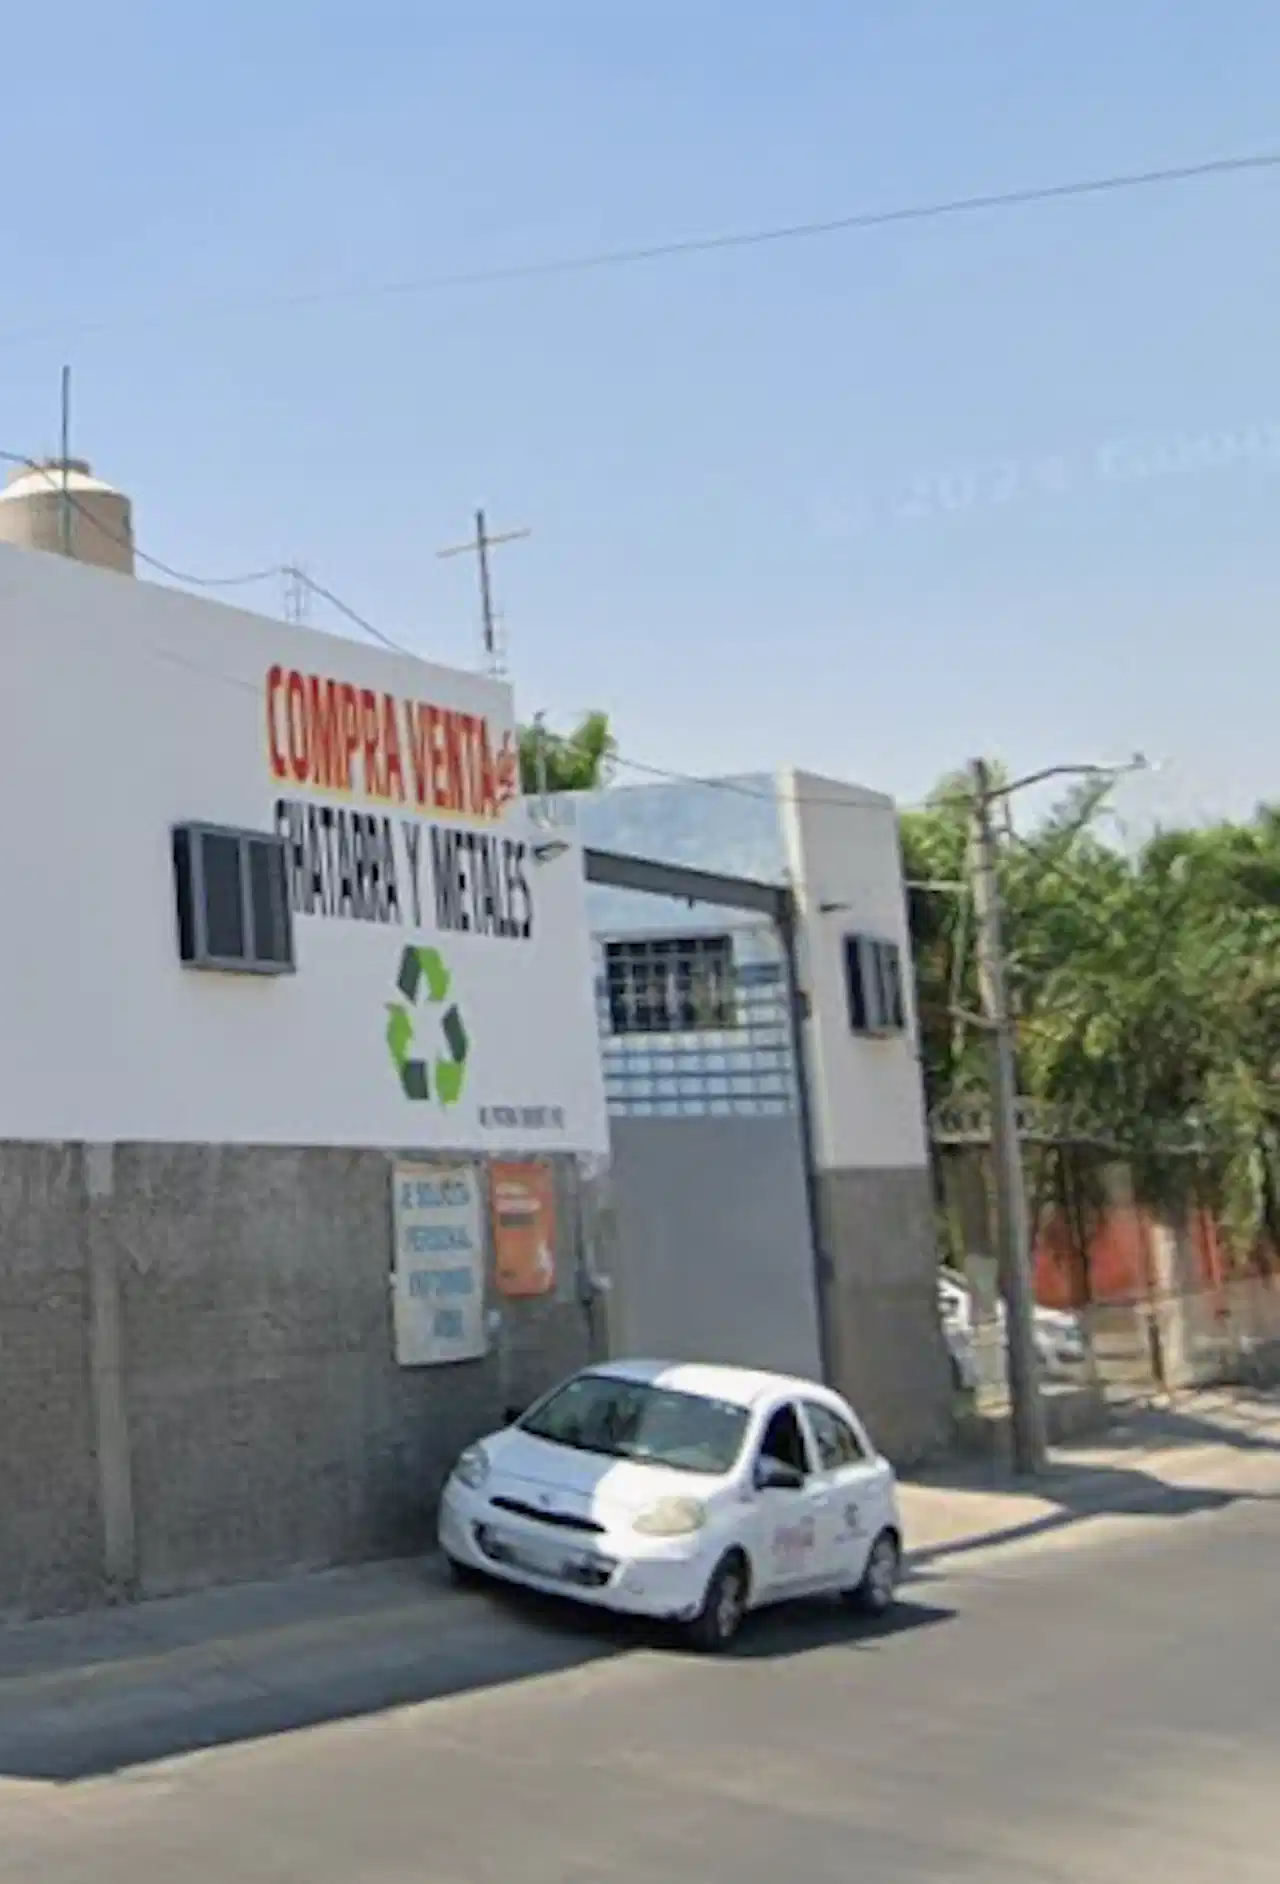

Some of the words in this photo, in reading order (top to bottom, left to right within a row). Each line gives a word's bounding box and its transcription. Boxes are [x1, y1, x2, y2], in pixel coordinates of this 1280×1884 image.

[268, 665, 404, 804] COMPRA
[403, 699, 500, 818] VENTA
[401, 821, 421, 927] Y
[429, 823, 533, 939] METALES
